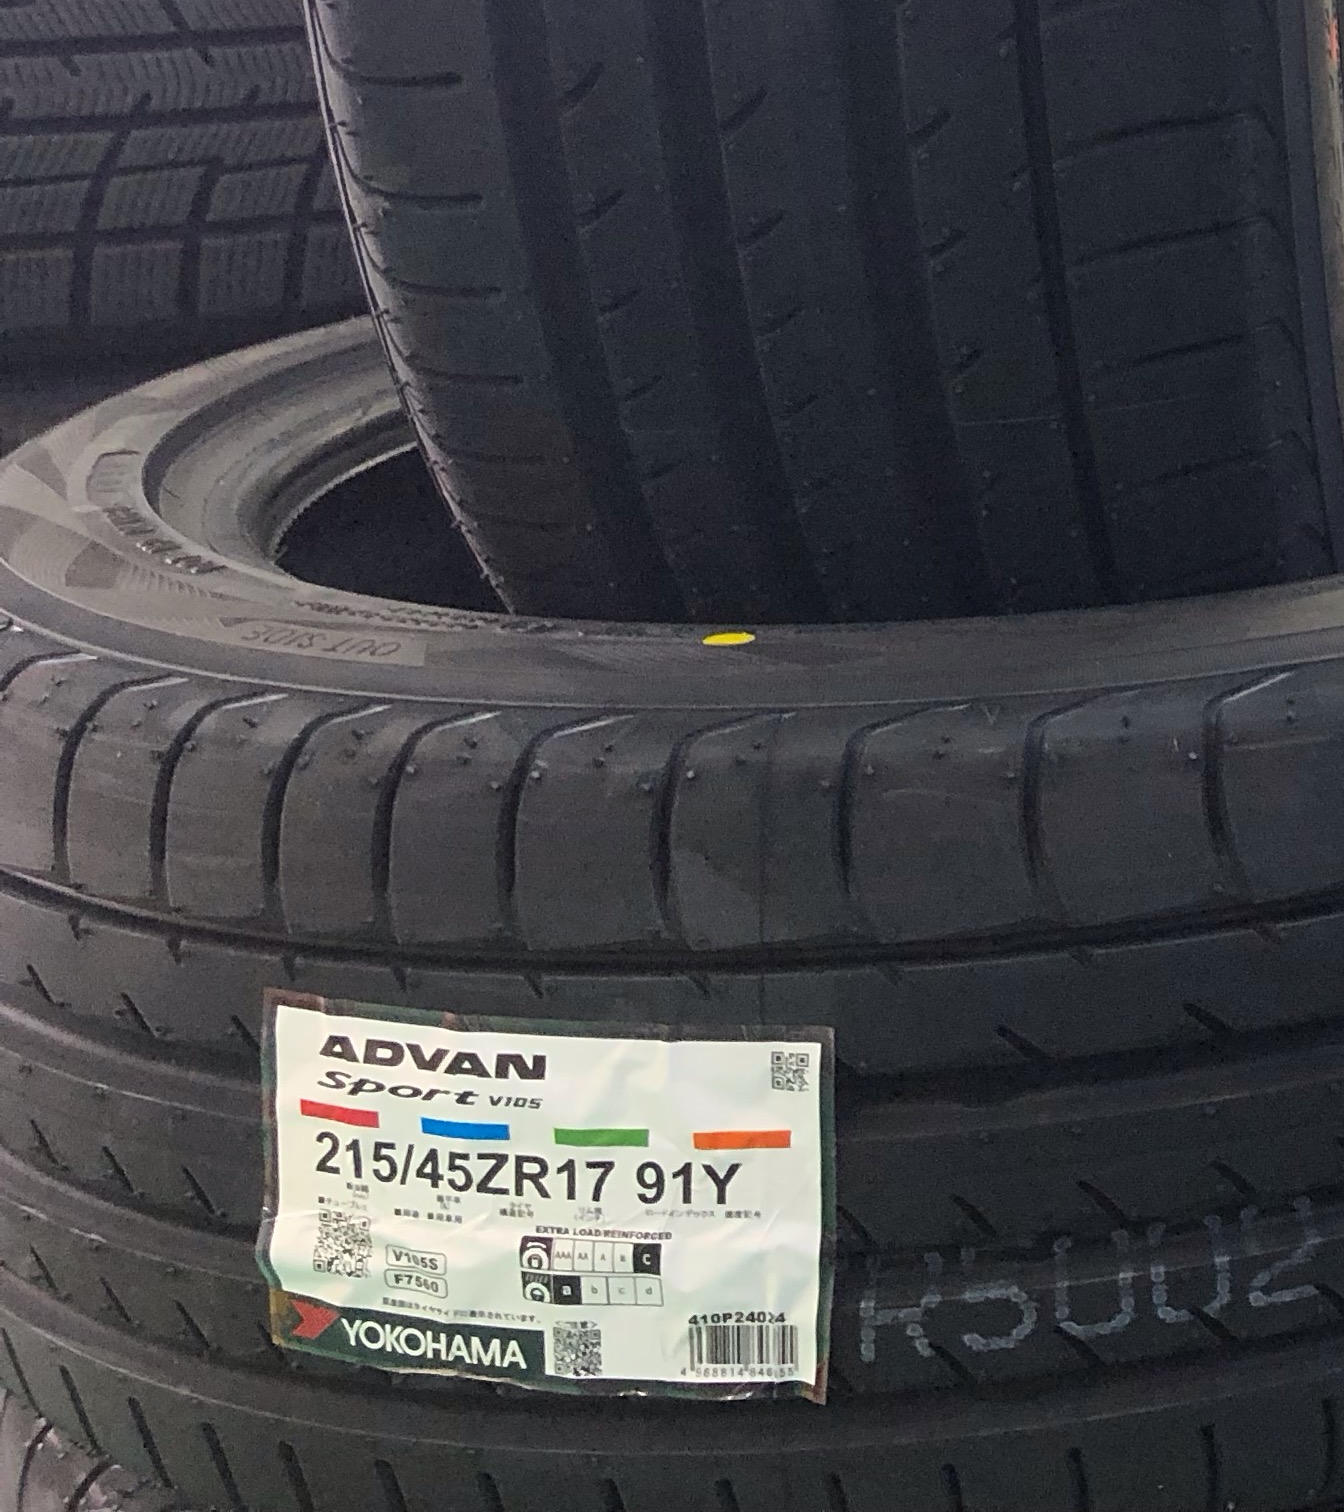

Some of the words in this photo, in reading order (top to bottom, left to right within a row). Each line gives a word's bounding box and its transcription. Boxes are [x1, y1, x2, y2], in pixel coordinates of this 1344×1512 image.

[319, 1035, 547, 1080] ADVAN
[317, 1071, 480, 1106] Sport
[489, 1095, 544, 1109] V105
[315, 1131, 615, 1202] 215/45ZR17
[636, 1161, 743, 1205] 91Y
[536, 1225, 569, 1235] EXTRA
[392, 1249, 439, 1270] V105S
[642, 1253, 651, 1265] C
[341, 1317, 527, 1369] YOKOHAMA
